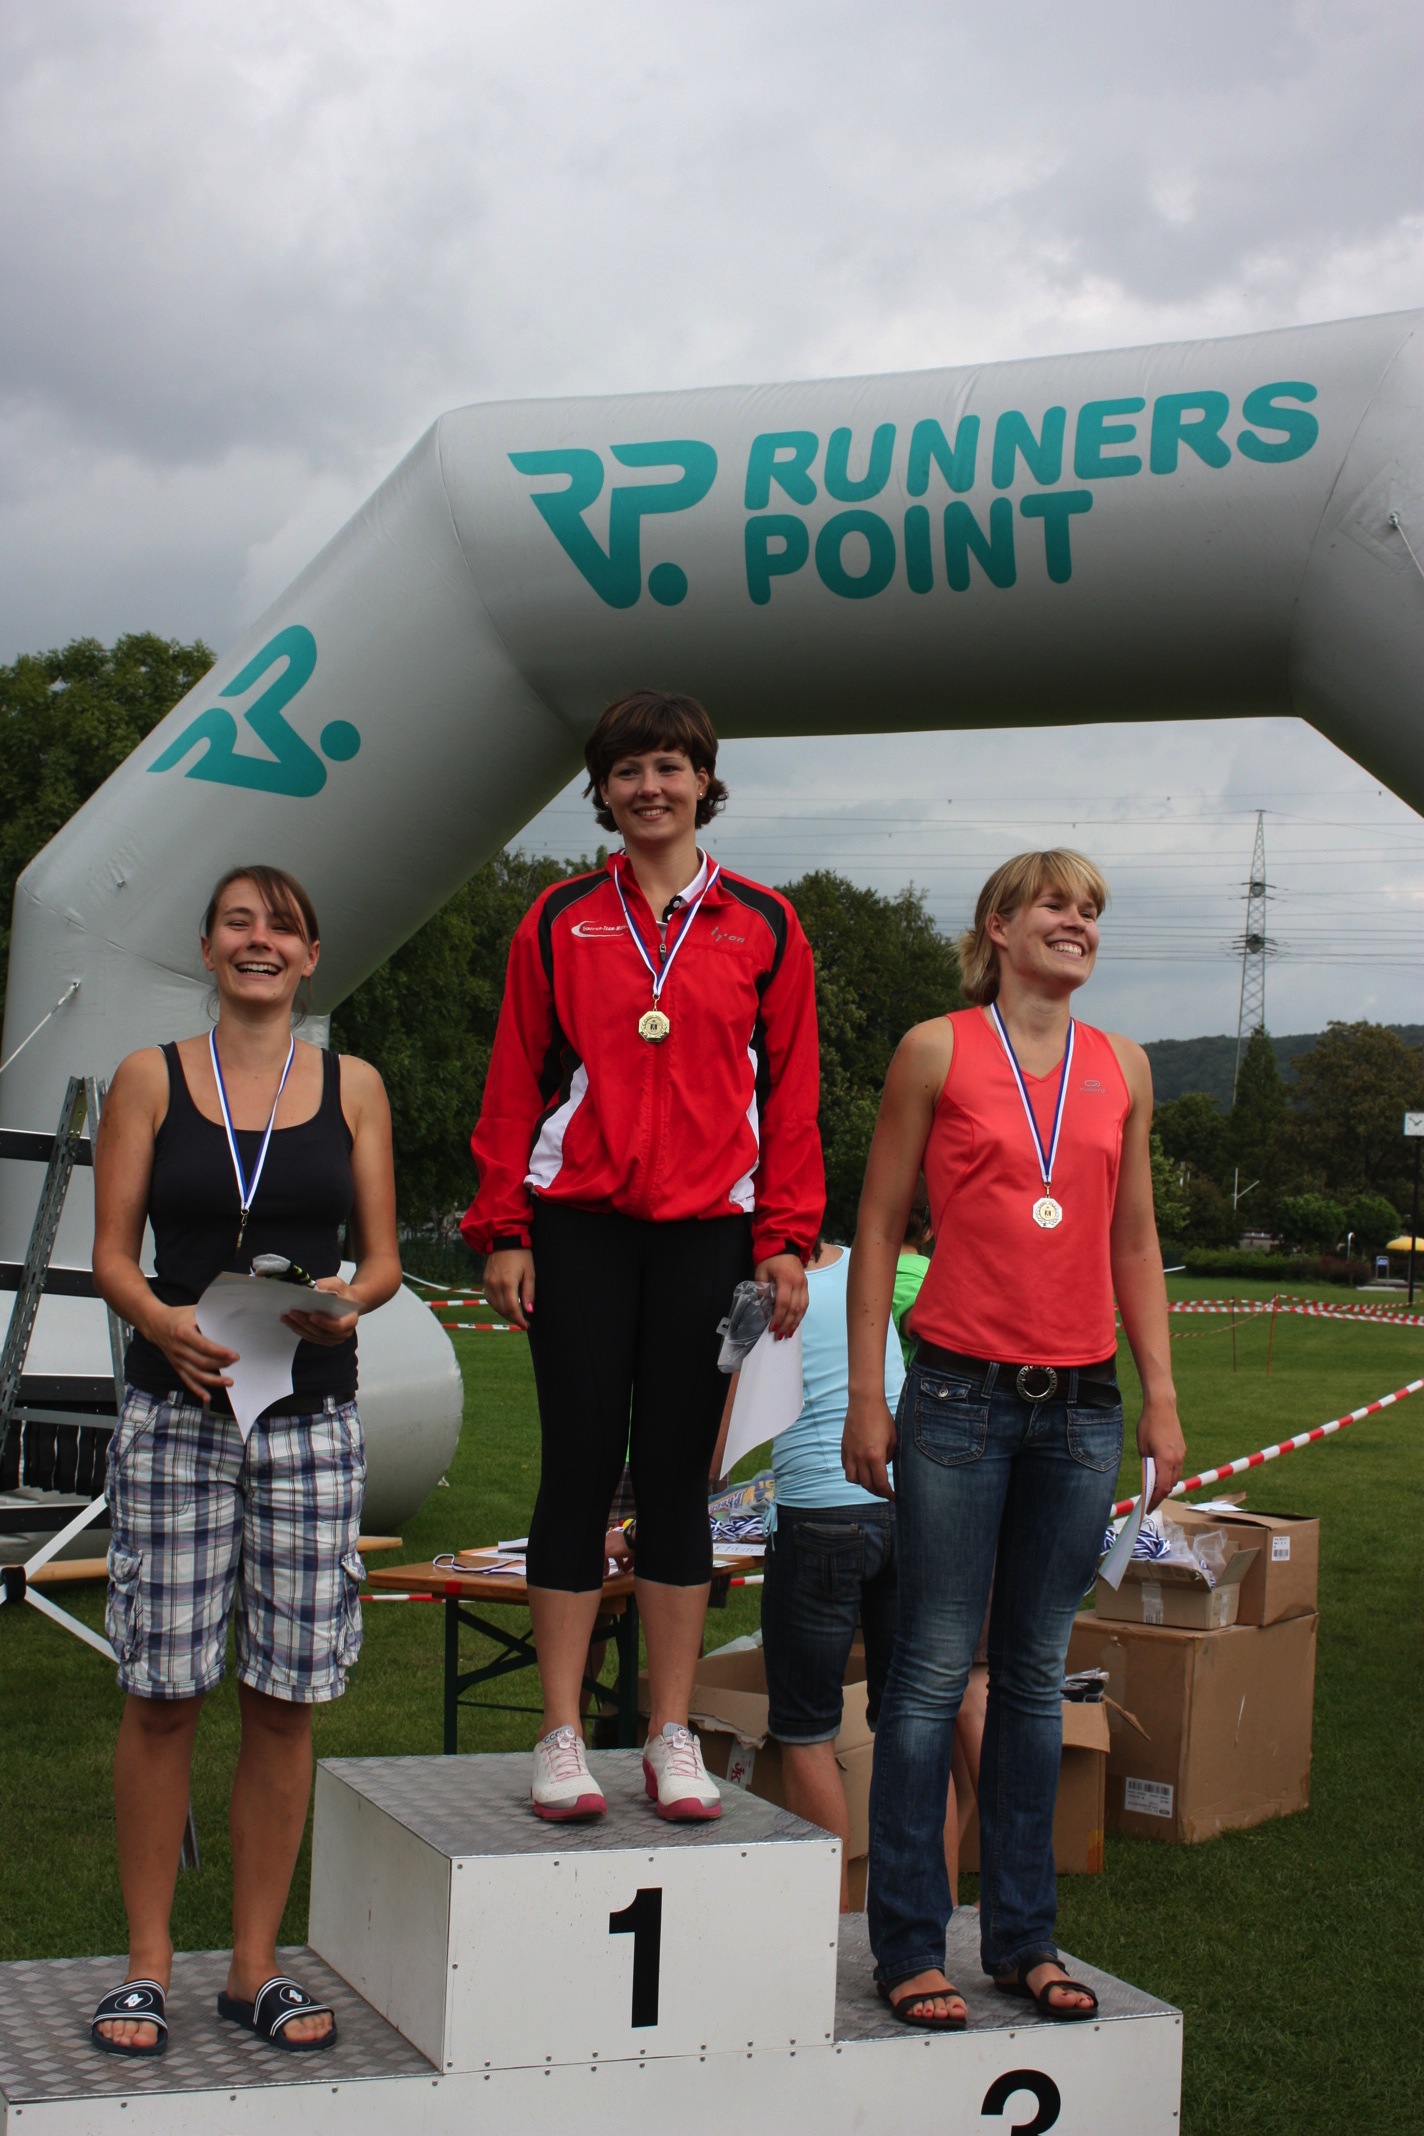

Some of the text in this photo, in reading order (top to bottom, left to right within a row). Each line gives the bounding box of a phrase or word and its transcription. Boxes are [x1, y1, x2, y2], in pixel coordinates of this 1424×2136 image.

[744, 381, 1319, 511] RUNNERS
[744, 489, 1094, 606] POINT
[608, 1887, 663, 2028] 1
